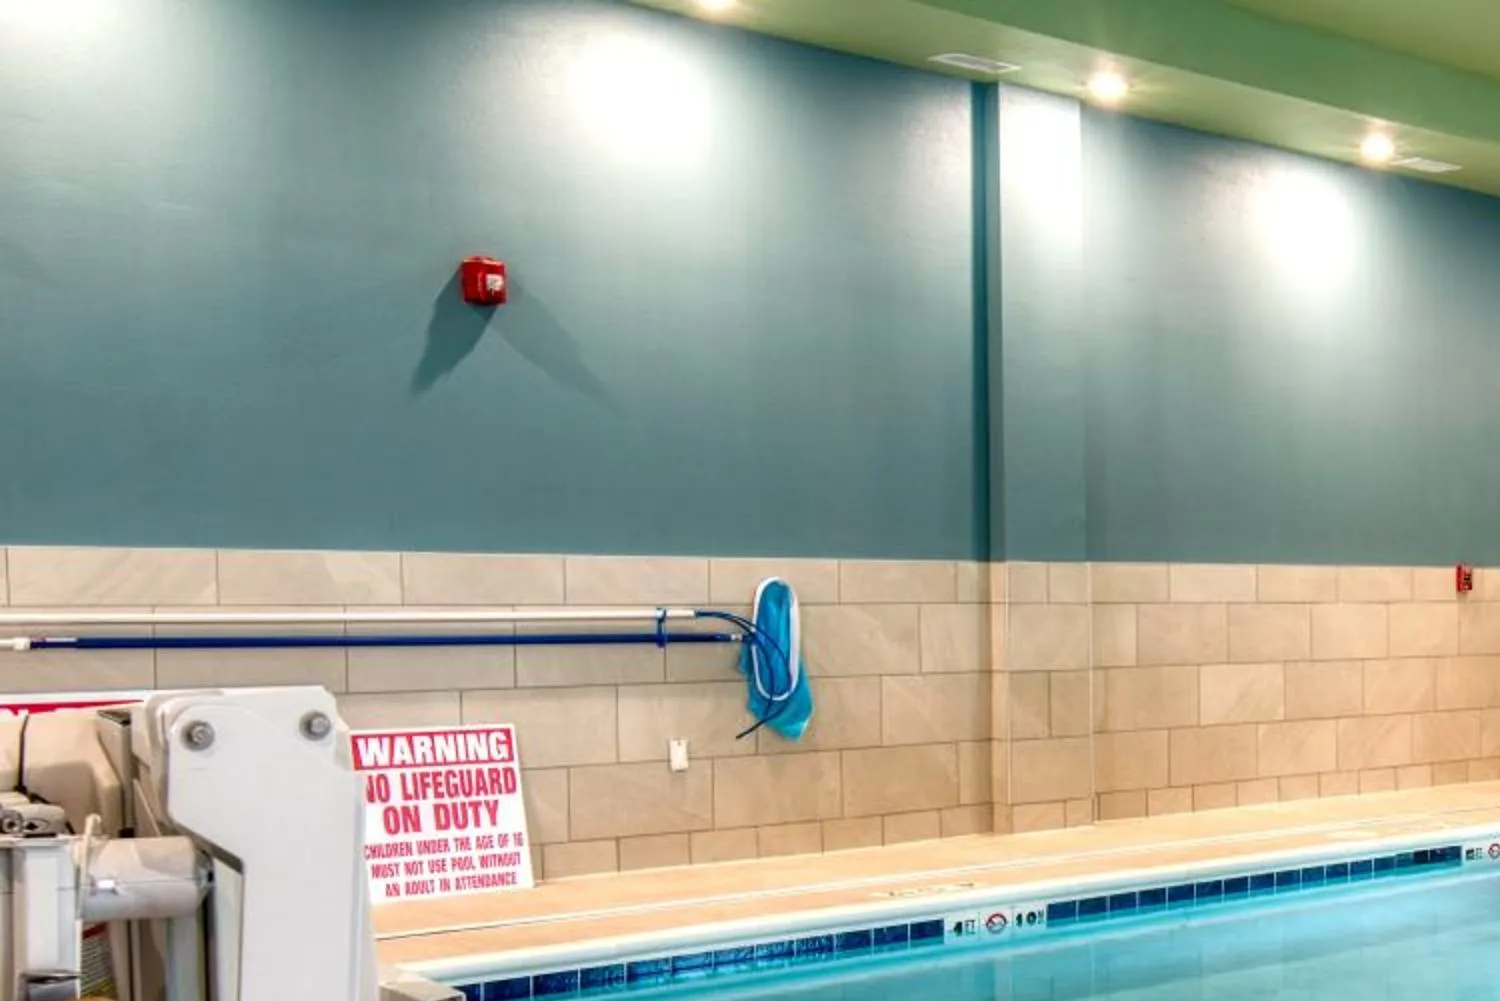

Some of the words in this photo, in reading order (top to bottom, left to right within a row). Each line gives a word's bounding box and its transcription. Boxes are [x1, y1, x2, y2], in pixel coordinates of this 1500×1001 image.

[356, 732, 509, 767] WARNING
[400, 766, 517, 801] LIFEGUARD
[383, 804, 421, 835] ON
[434, 799, 499, 831] DUTY
[364, 841, 413, 860] CHILDREN
[416, 838, 450, 855] UNDER
[454, 836, 472, 852] THE
[476, 835, 494, 849] AGE
[498, 833, 509, 848] OF
[371, 862, 400, 879] MUST
[404, 860, 424, 876] NOT
[428, 858, 448, 873] USE
[451, 855, 476, 872] POOL
[478, 852, 521, 868] WITHOUT
[385, 883, 401, 897] AN
[405, 879, 435, 896] ADULT
[439, 877, 451, 892] IN
[455, 871, 518, 891] ATTENDANCE
